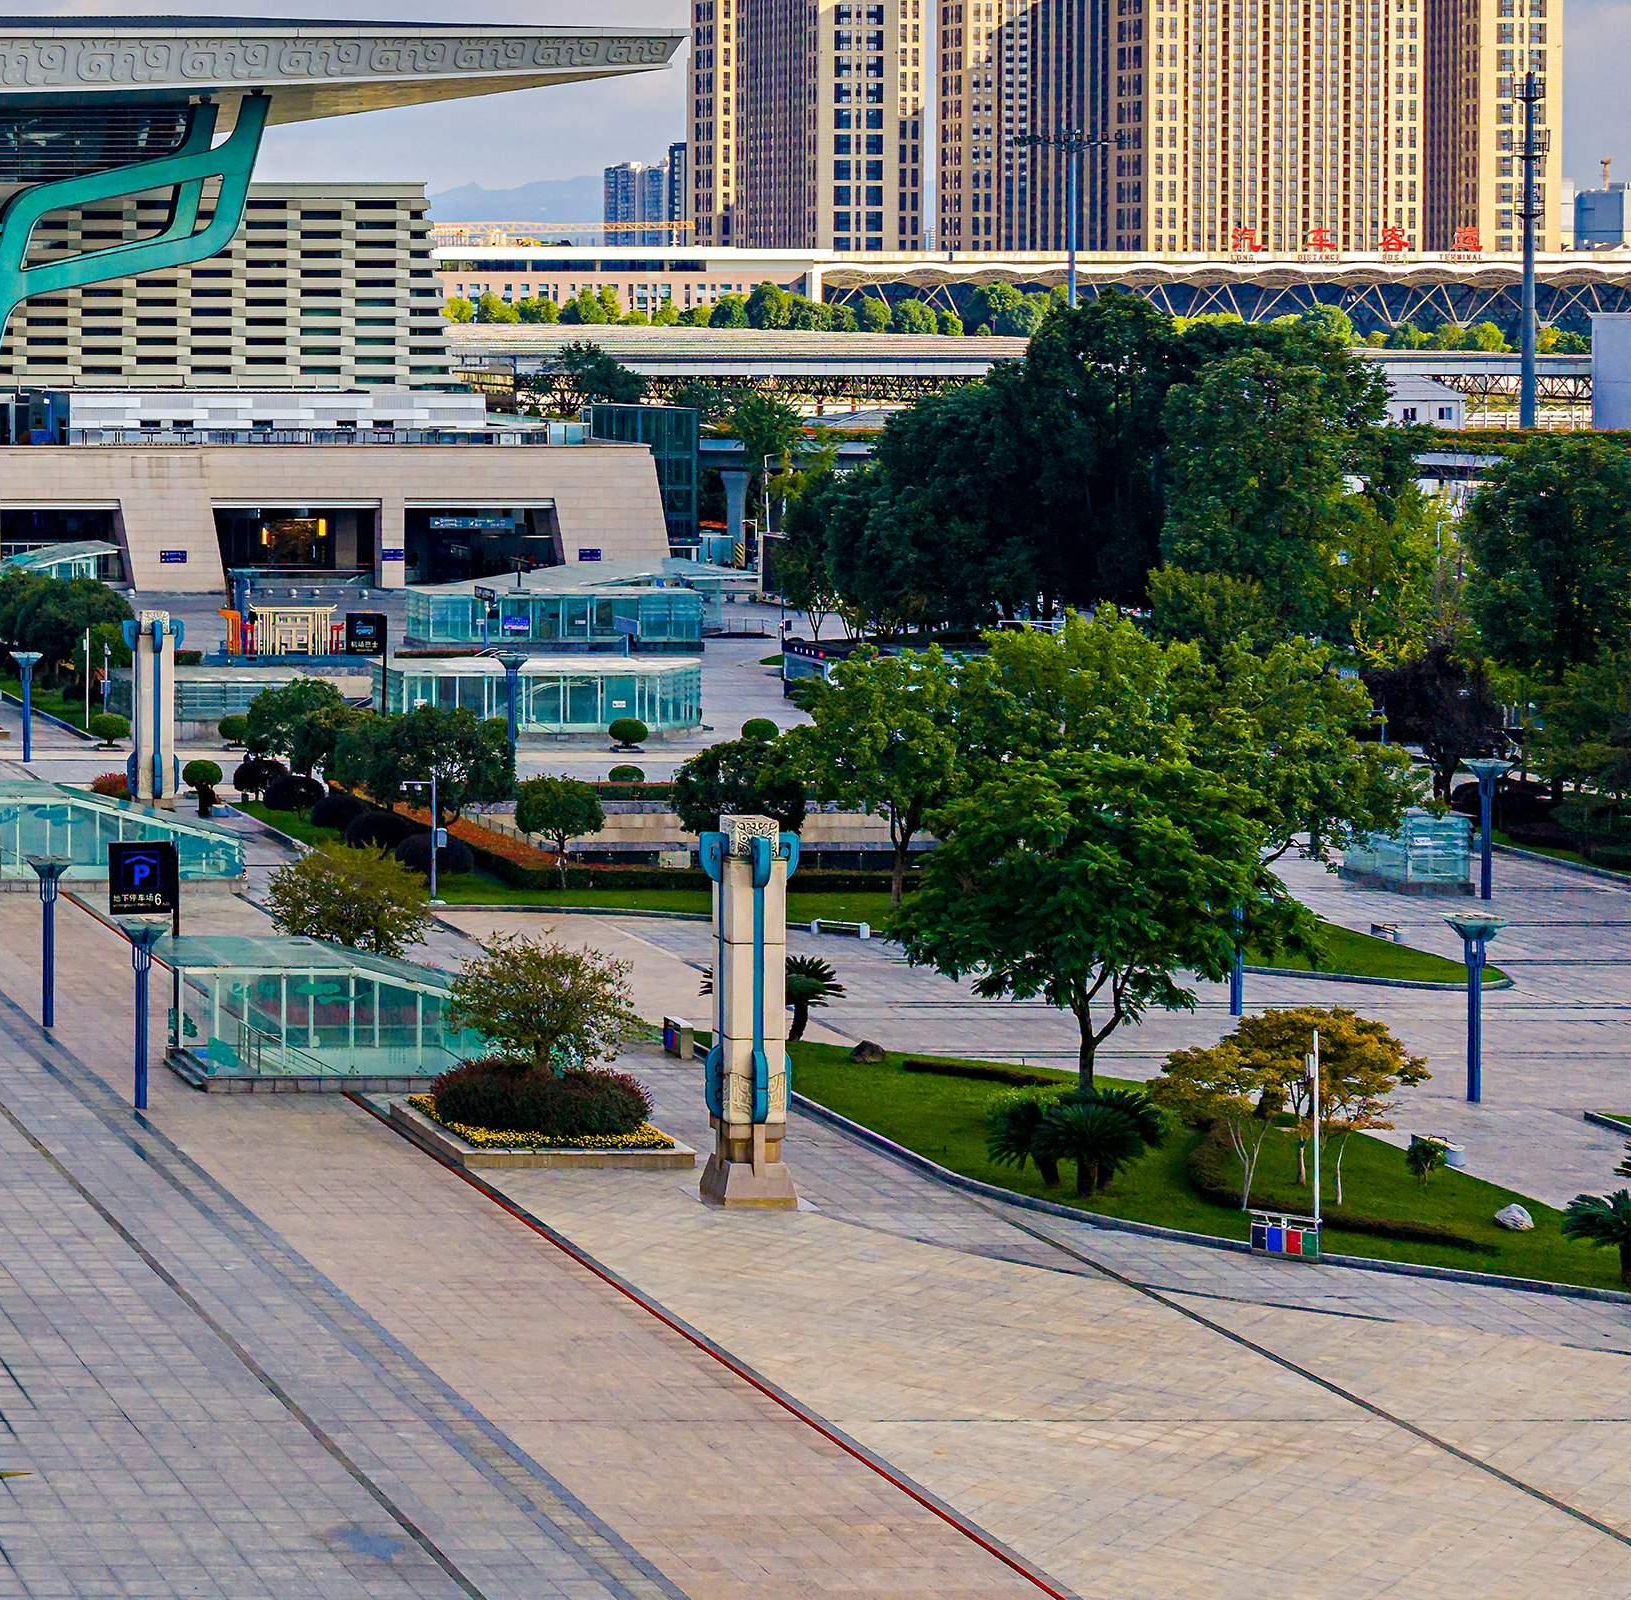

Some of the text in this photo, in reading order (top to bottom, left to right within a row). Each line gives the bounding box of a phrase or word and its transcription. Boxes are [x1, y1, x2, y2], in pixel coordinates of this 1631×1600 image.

[350, 641, 379, 649] 机场巴士
[113, 893, 162, 906] 地下停车场 6
